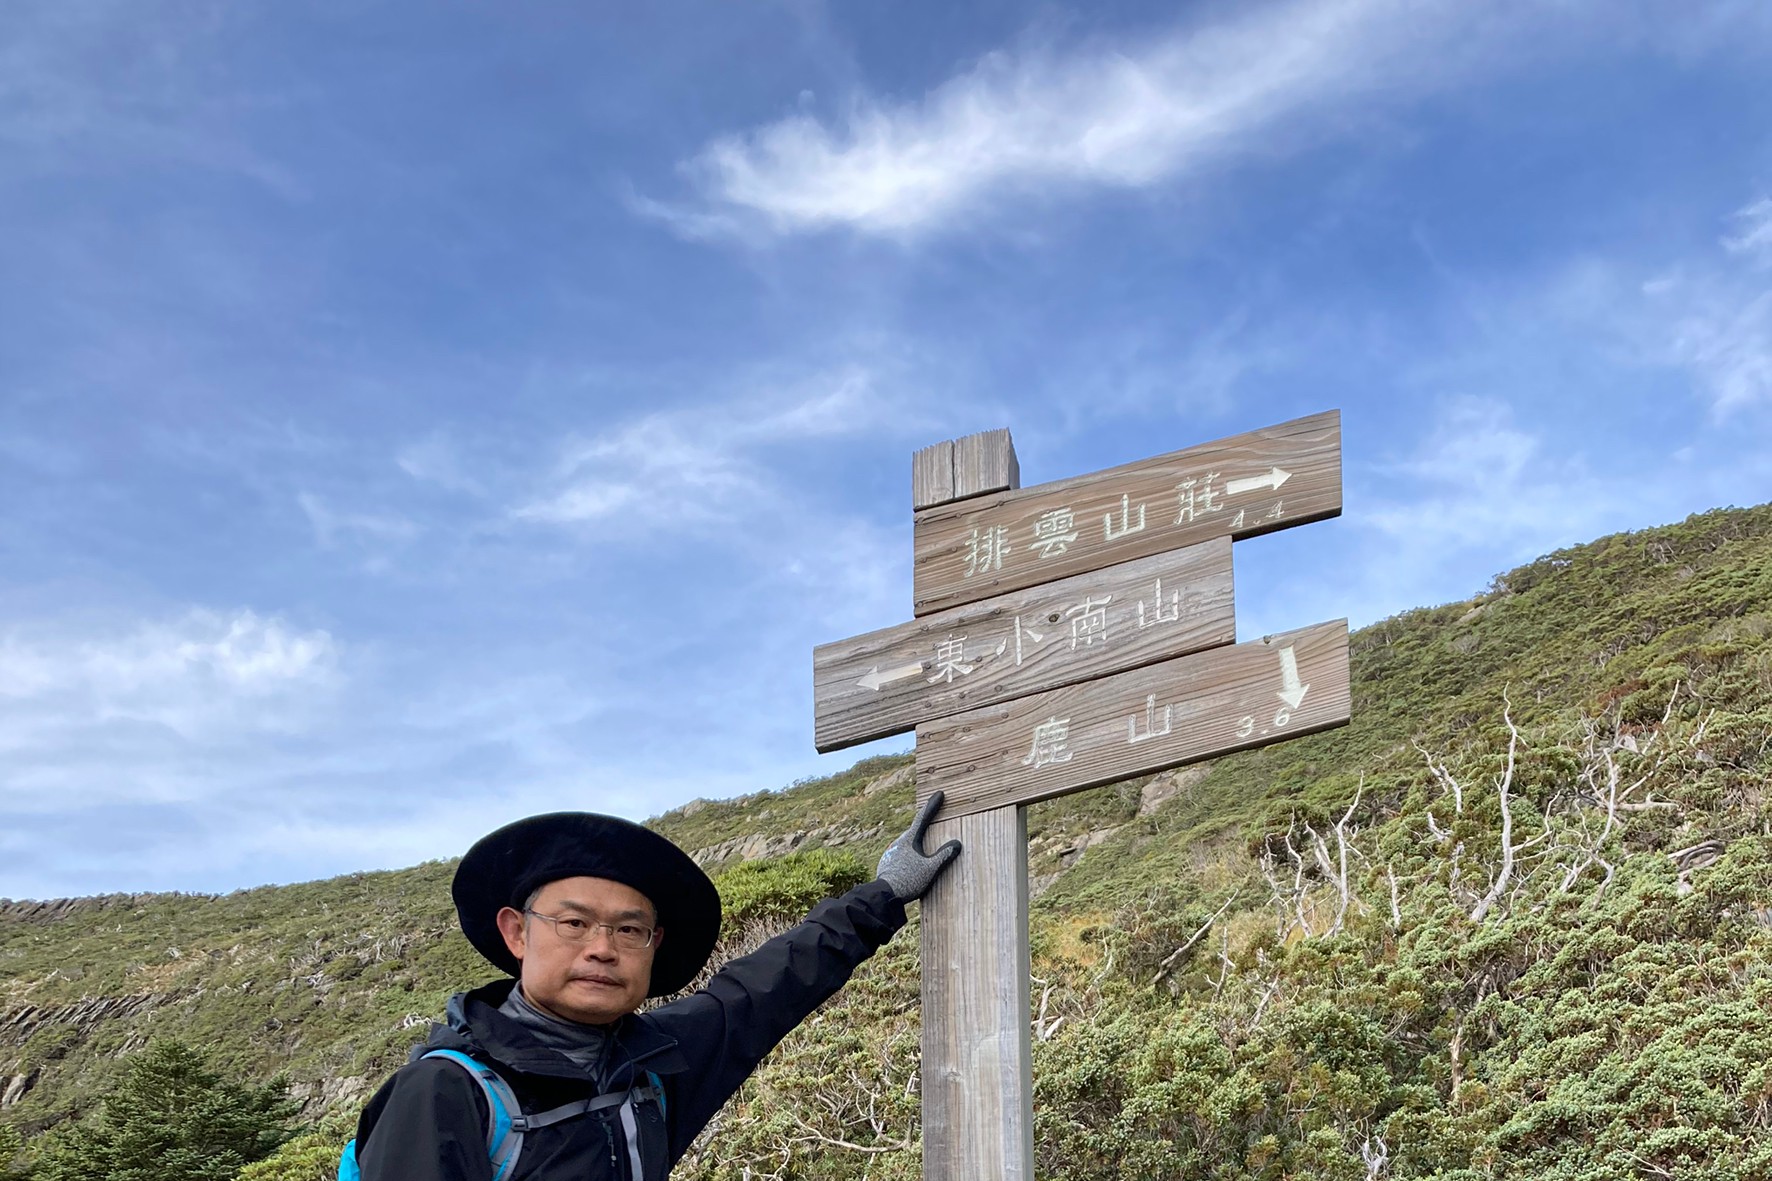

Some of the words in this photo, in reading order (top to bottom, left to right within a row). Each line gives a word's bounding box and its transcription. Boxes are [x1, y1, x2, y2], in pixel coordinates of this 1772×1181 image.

[963, 470, 1223, 577] 排雲山莊
[927, 578, 1180, 683] 東小南山
[1020, 693, 1174, 769] 鹿山
[1236, 707, 1290, 738] 3.6
